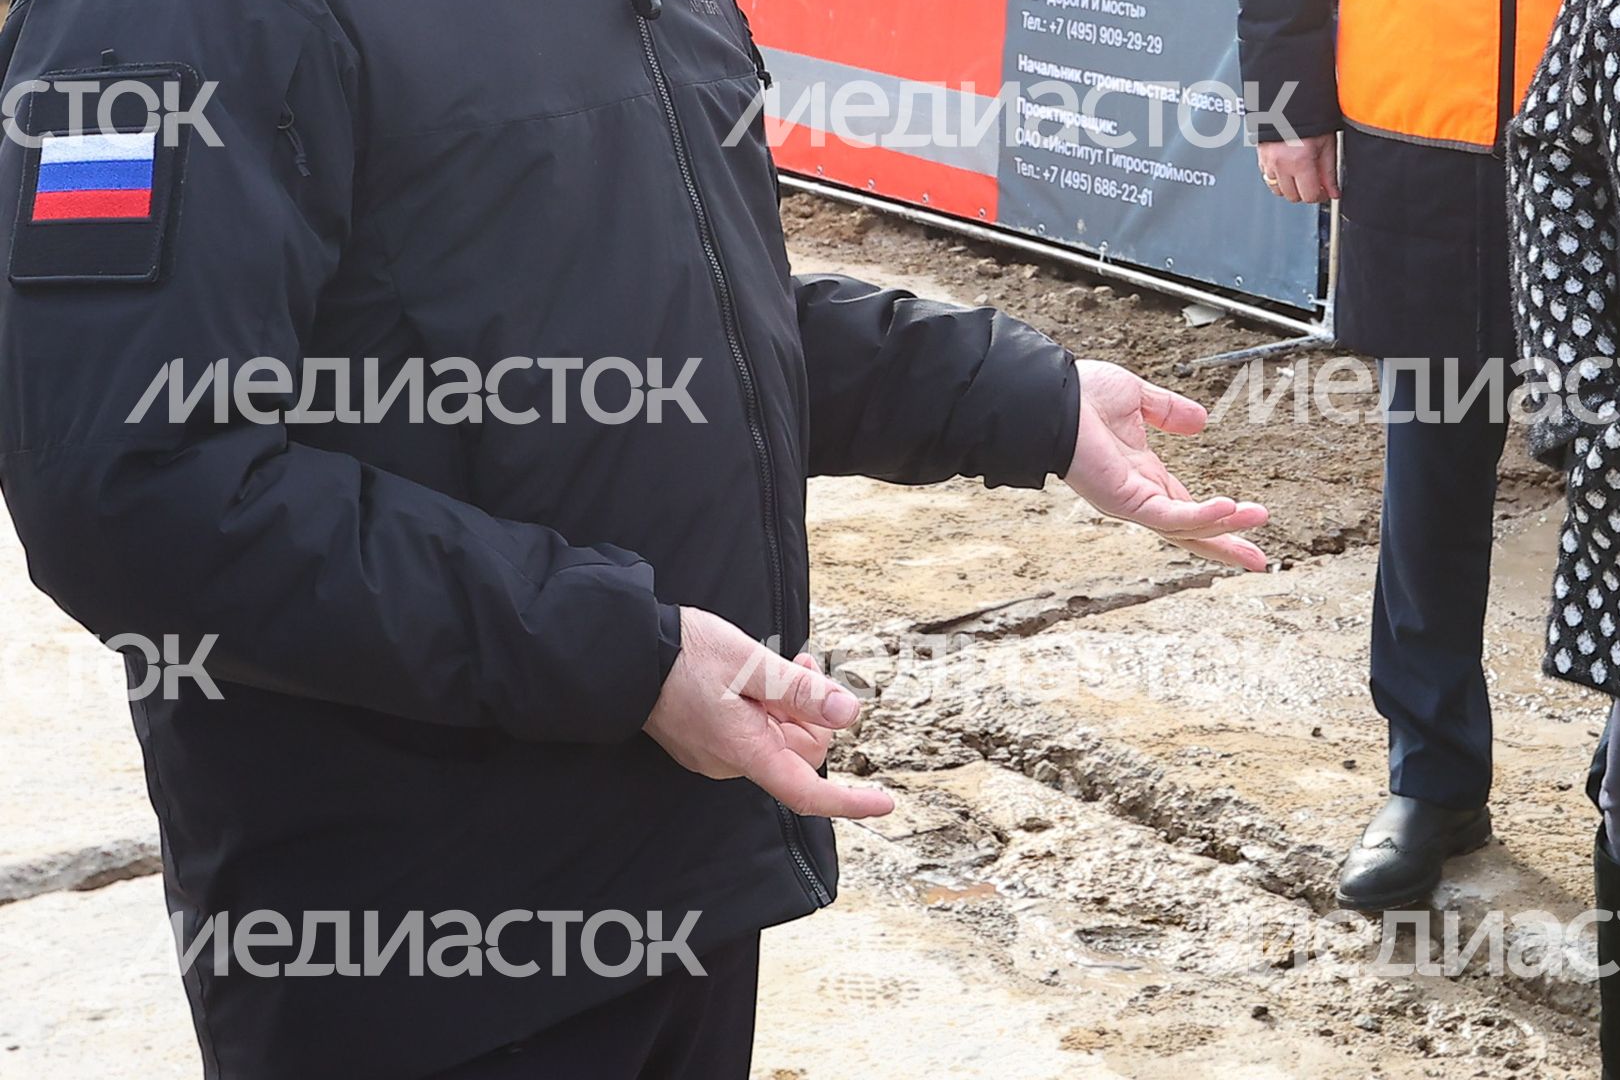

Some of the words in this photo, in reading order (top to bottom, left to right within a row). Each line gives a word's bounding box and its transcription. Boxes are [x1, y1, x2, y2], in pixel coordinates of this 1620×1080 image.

[1021, 10, 1047, 33] Тел.:
[1049, 17, 1063, 35] +7
[1066, 19, 1097, 45] (495)
[1099, 26, 1163, 55] 909-29-29
[1018, 53, 1082, 83] Начальник
[1082, 70, 1181, 103] строительства:
[1016, 96, 1119, 135] Проектировщик:
[1015, 127, 1041, 149] ОАО
[1042, 135, 1104, 165] «Институт
[1014, 156, 1041, 180] Тел.:
[1042, 164, 1058, 183] +7
[1060, 167, 1092, 195] (495)
